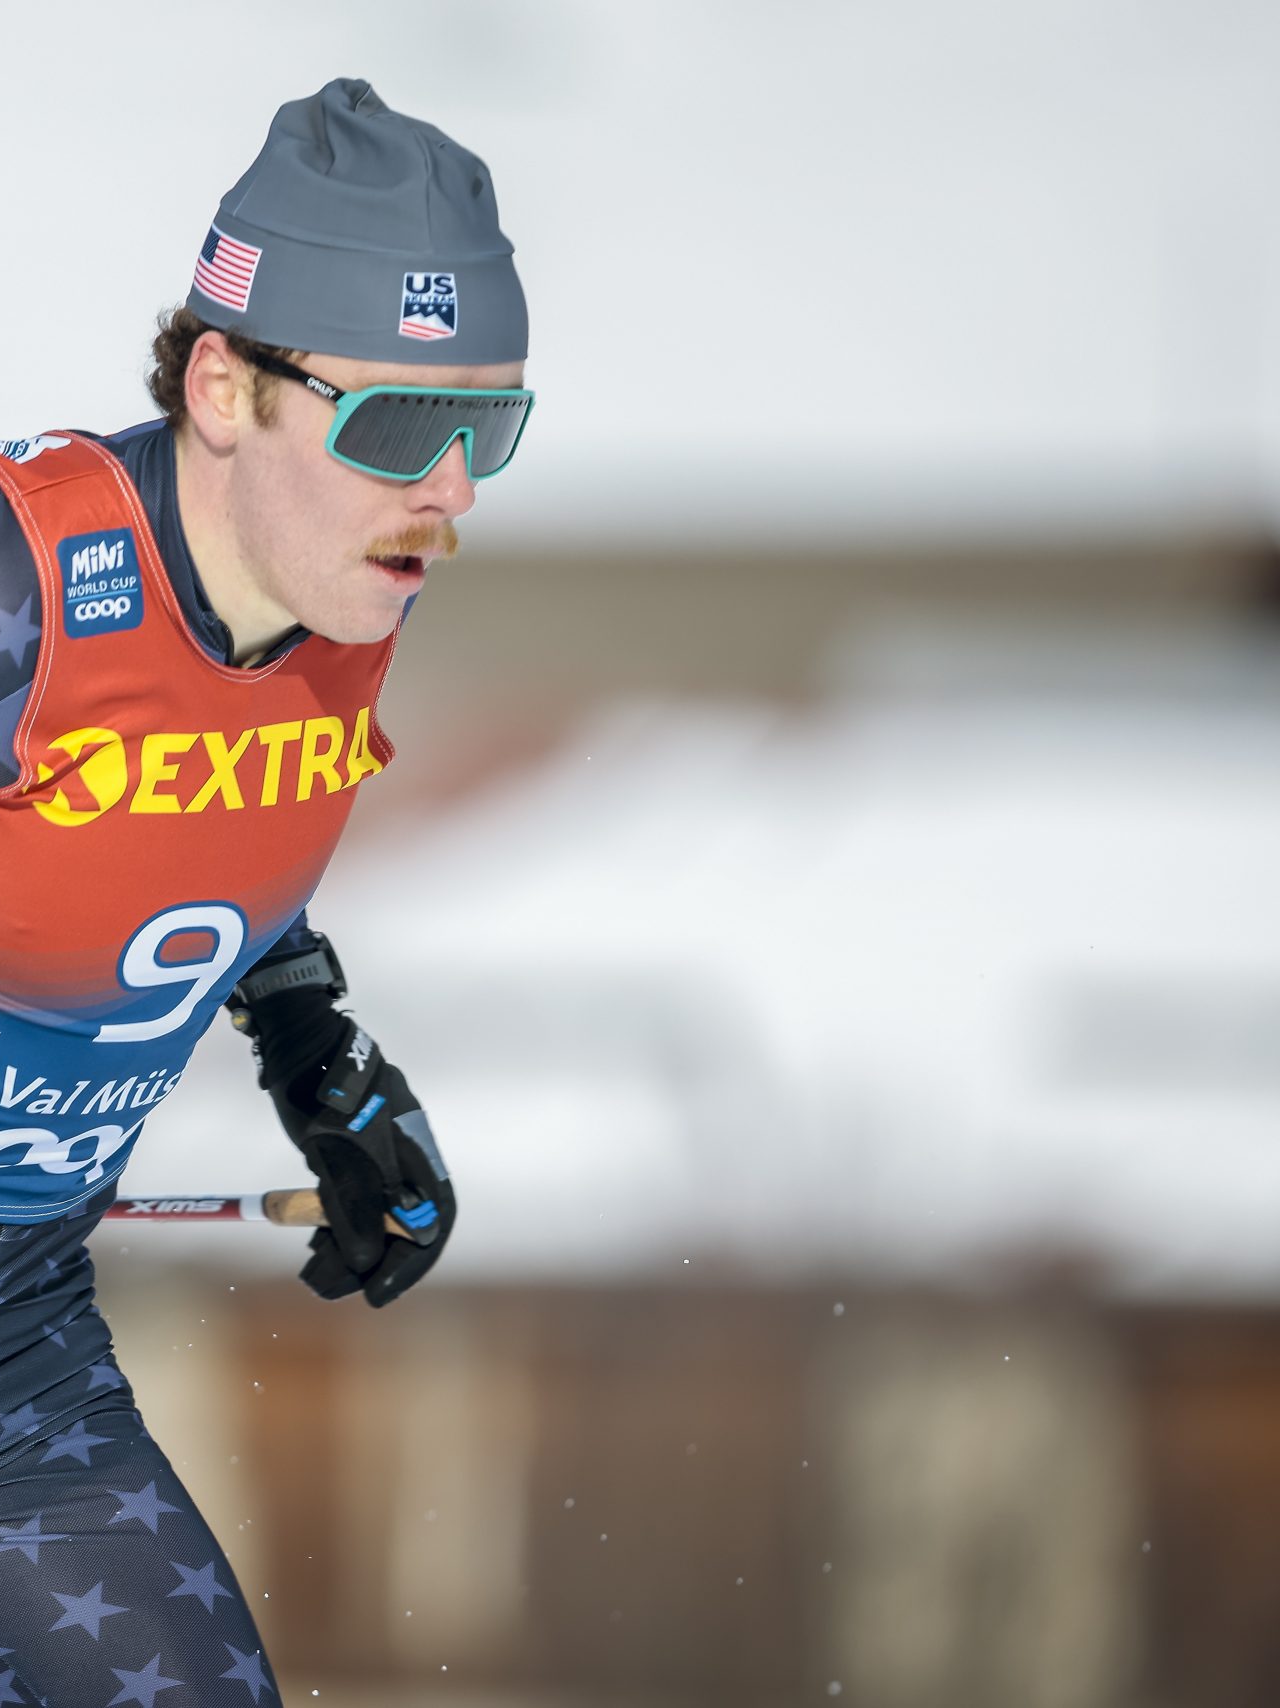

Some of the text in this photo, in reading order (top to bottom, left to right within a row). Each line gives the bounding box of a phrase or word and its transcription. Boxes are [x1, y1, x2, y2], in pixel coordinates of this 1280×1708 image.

[406, 275, 453, 294] US
[67, 575, 137, 598] WORLD CUP
[74, 596, 131, 621] coop
[128, 706, 384, 814] EXTRA
[92, 903, 245, 1043] 9
[0, 1065, 91, 1115] Val
